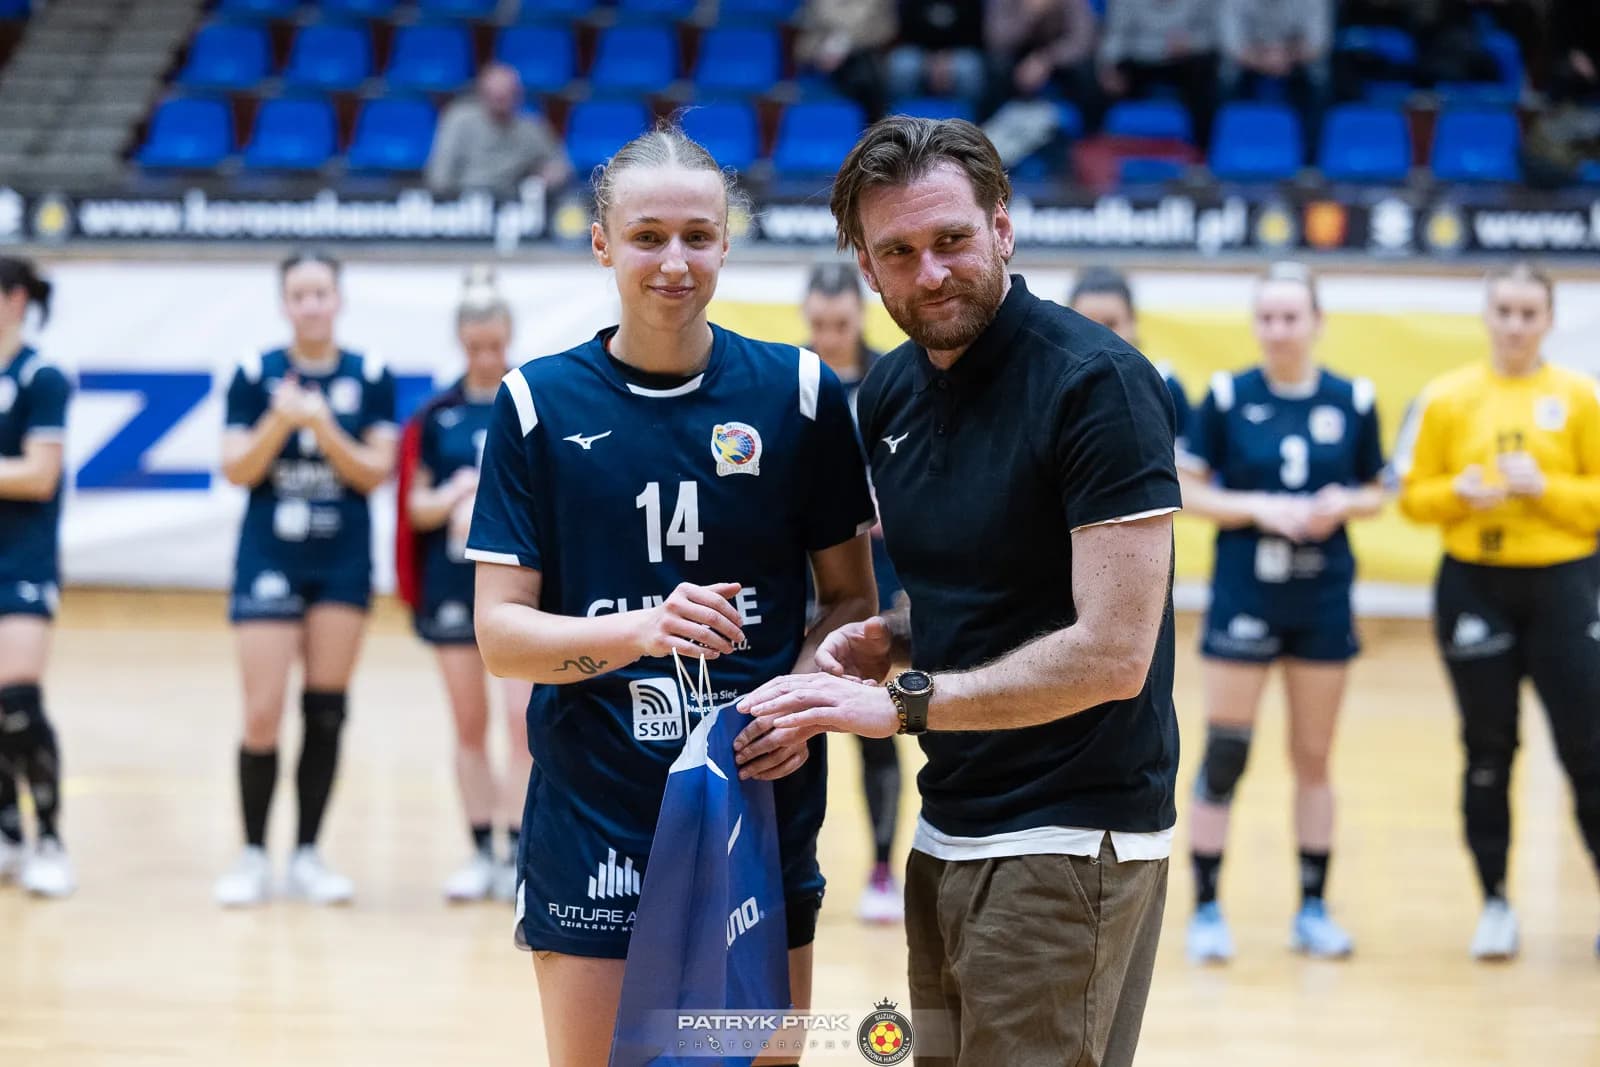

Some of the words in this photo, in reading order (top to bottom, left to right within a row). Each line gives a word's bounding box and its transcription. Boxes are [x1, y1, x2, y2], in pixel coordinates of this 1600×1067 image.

[1280, 435, 1309, 488] 3
[635, 480, 704, 563] 14
[638, 721, 678, 737] SSM
